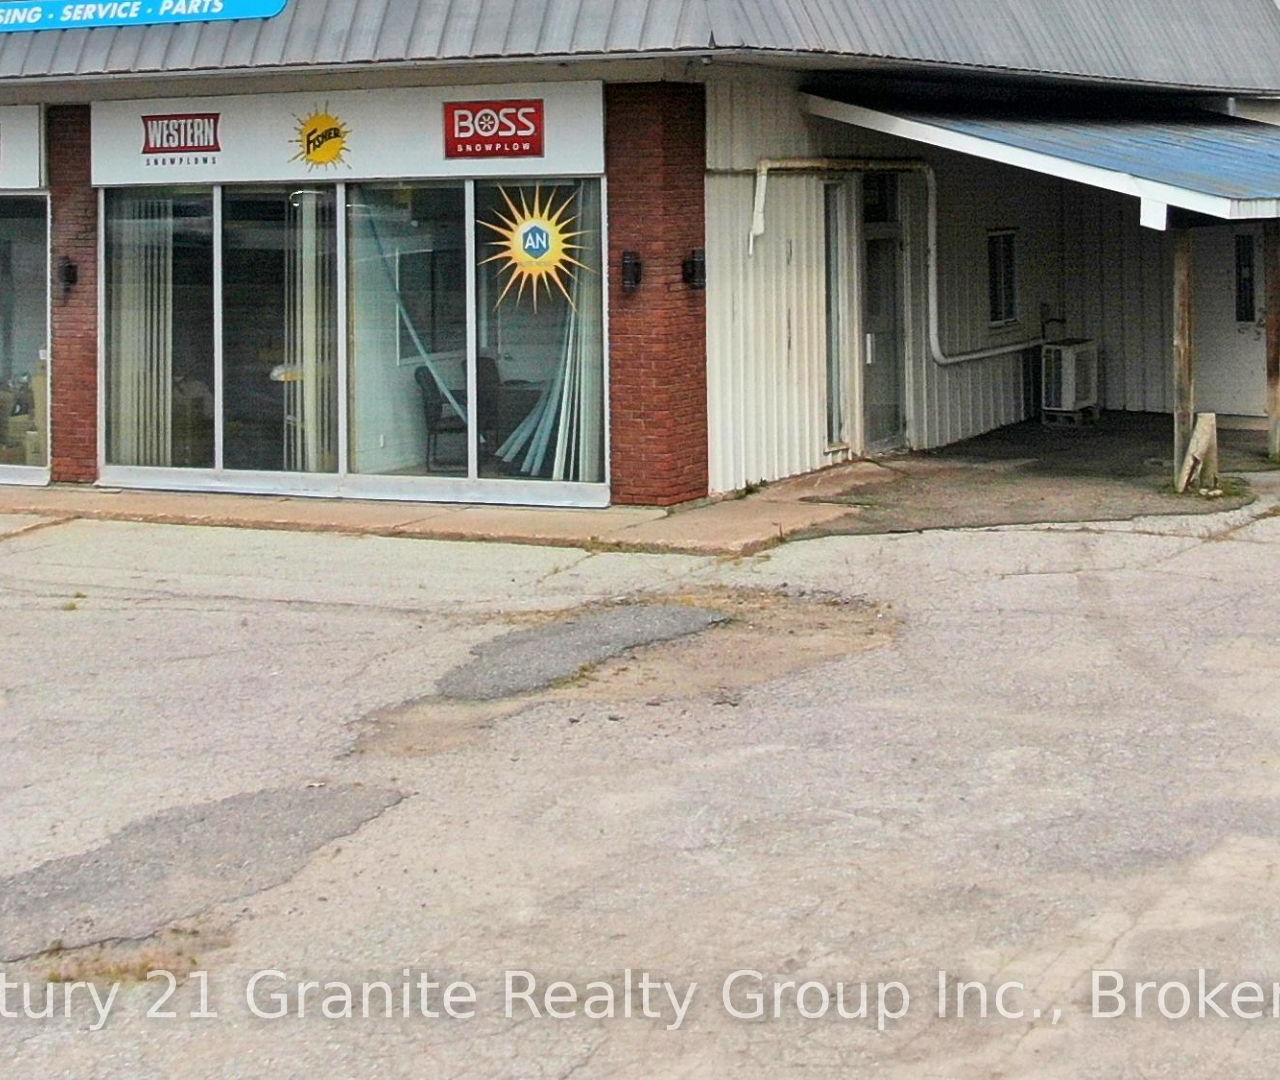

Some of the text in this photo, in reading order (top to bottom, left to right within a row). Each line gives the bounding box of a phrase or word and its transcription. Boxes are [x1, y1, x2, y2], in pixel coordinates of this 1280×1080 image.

[60, 1, 141, 22] SERVICE
[453, 107, 537, 138] BOSS
[147, 118, 215, 149] WESTERN
[456, 142, 531, 152] SNOWPLOW
[145, 156, 217, 167] SNOWPLOWS
[524, 232, 548, 250] AN
